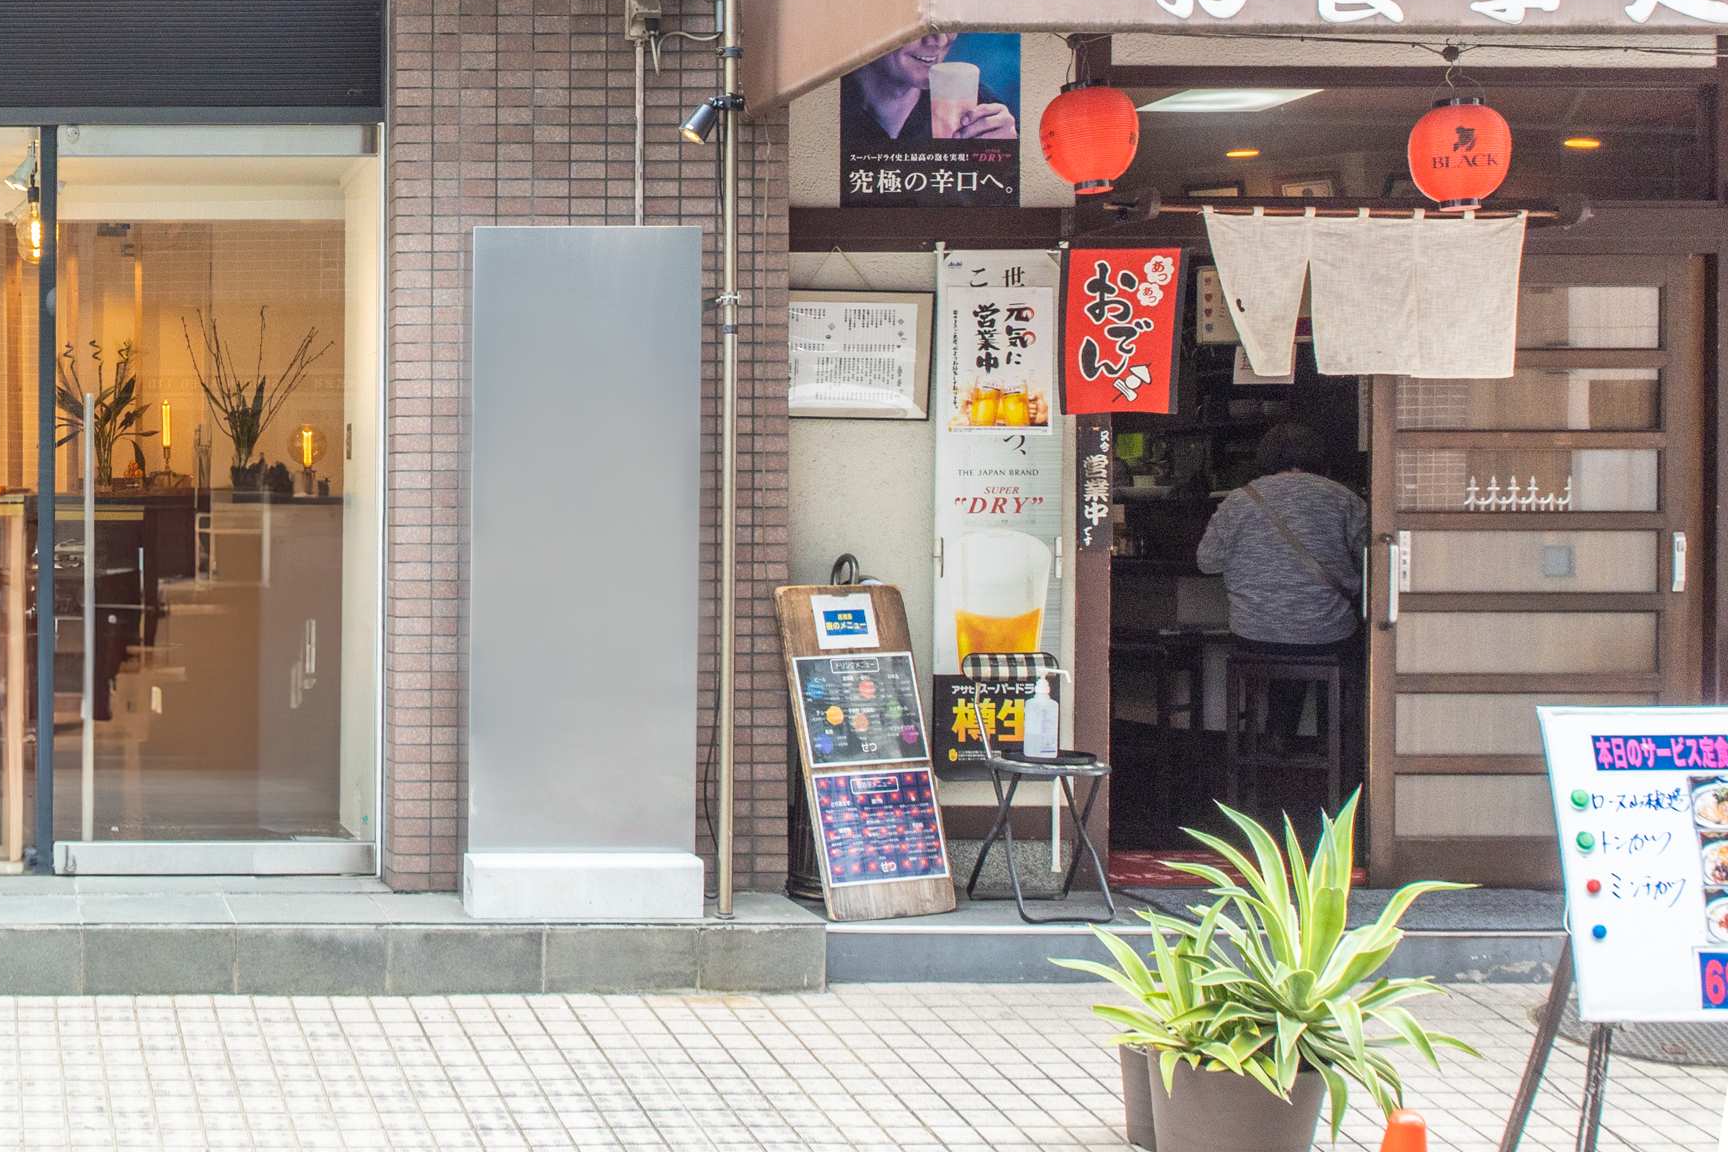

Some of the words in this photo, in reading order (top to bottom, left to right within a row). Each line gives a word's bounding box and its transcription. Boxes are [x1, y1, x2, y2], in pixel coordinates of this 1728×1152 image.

[1432, 154, 1498, 169] BLACK
[849, 169, 1013, 194] 究極の辛口へ。
[1152, 261, 1168, 282] あつ
[1143, 287, 1158, 303] あつ
[1079, 260, 1154, 381] おでん
[973, 303, 1001, 375] 営業中
[1004, 303, 1029, 365] 元気に
[984, 486, 1019, 494] SUPER
[861, 742, 877, 752] せつ
[881, 861, 897, 872] せつ
[1705, 959, 1728, 1005] 6
